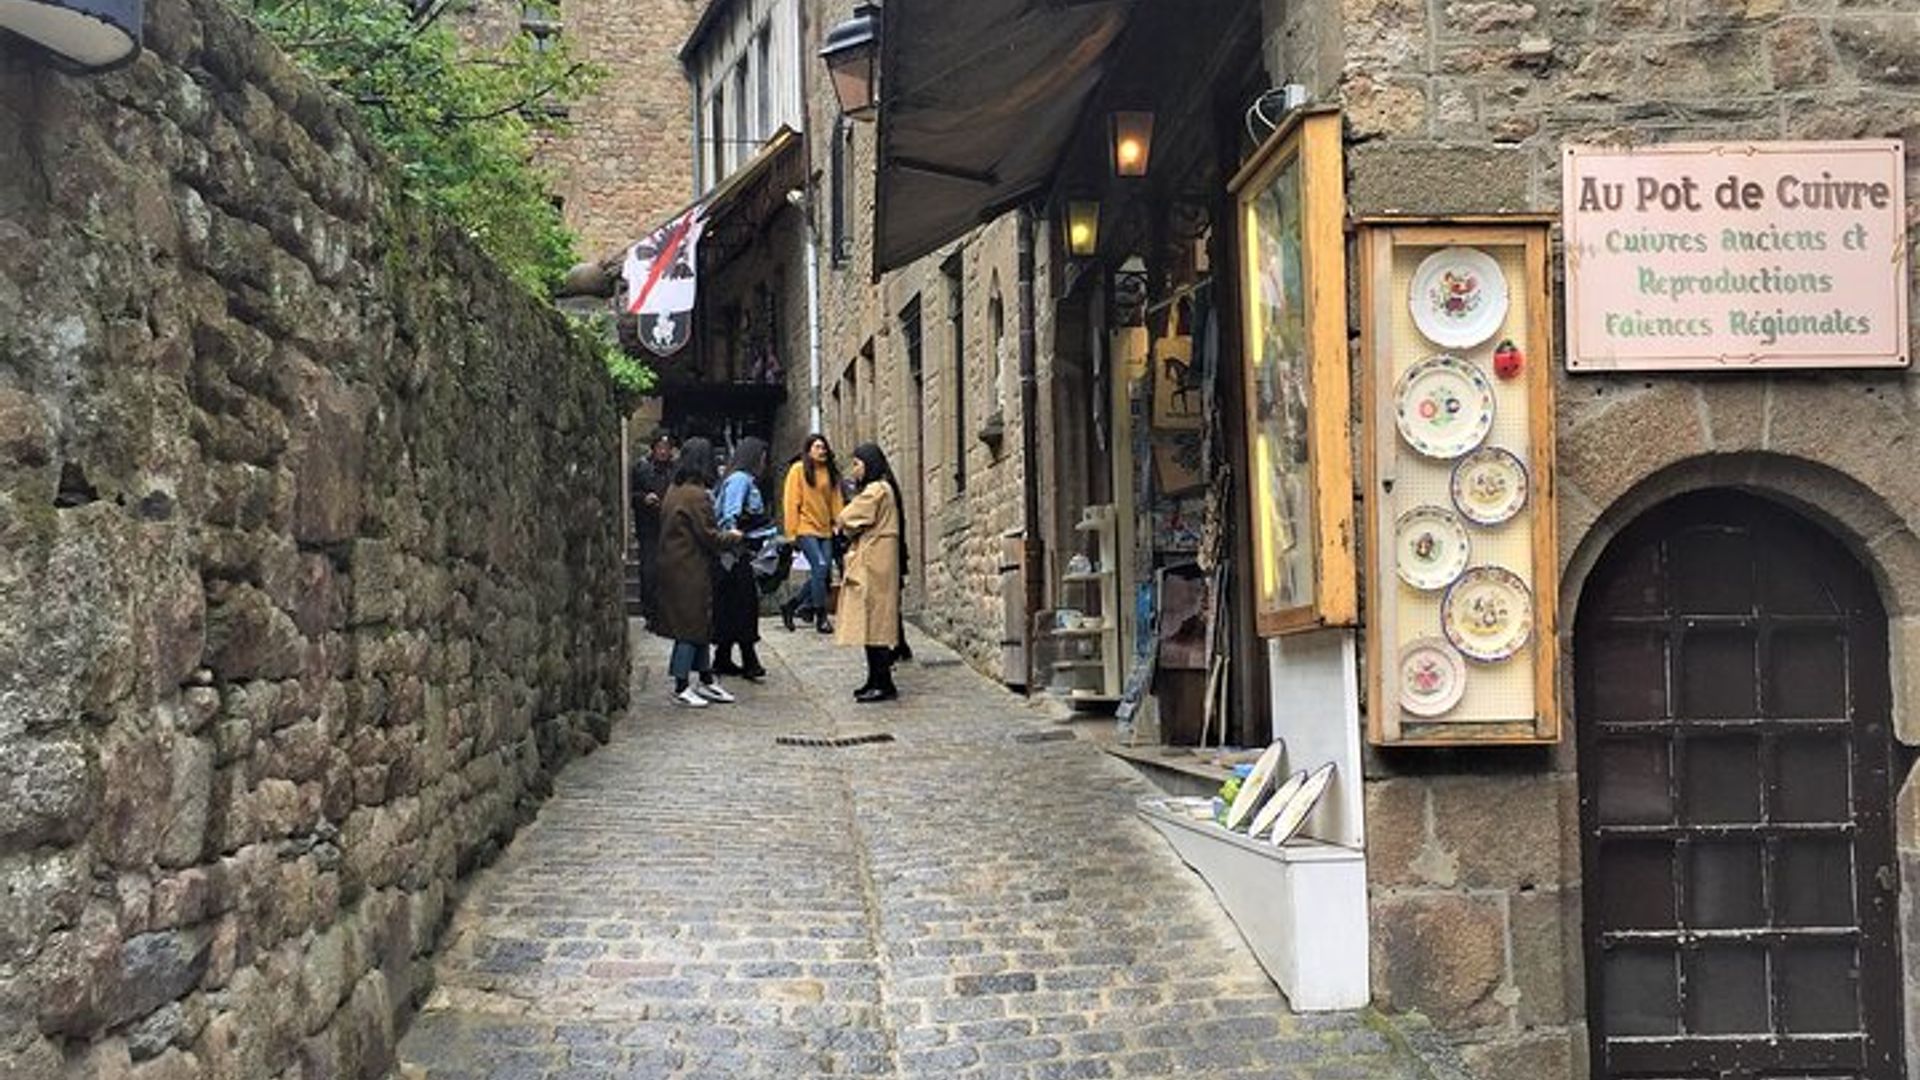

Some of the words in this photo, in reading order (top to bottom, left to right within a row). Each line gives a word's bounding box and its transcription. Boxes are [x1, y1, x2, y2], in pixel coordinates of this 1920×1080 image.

[1579, 176, 1623, 211] Au
[1637, 176, 1701, 211] Pot
[1715, 175, 1764, 210] de
[1777, 172, 1889, 209] Cuivre
[1605, 226, 1708, 253] Cuivres
[1843, 222, 1867, 250] et
[1637, 266, 1833, 300] Reproductions
[1729, 310, 1871, 345] Régionales
